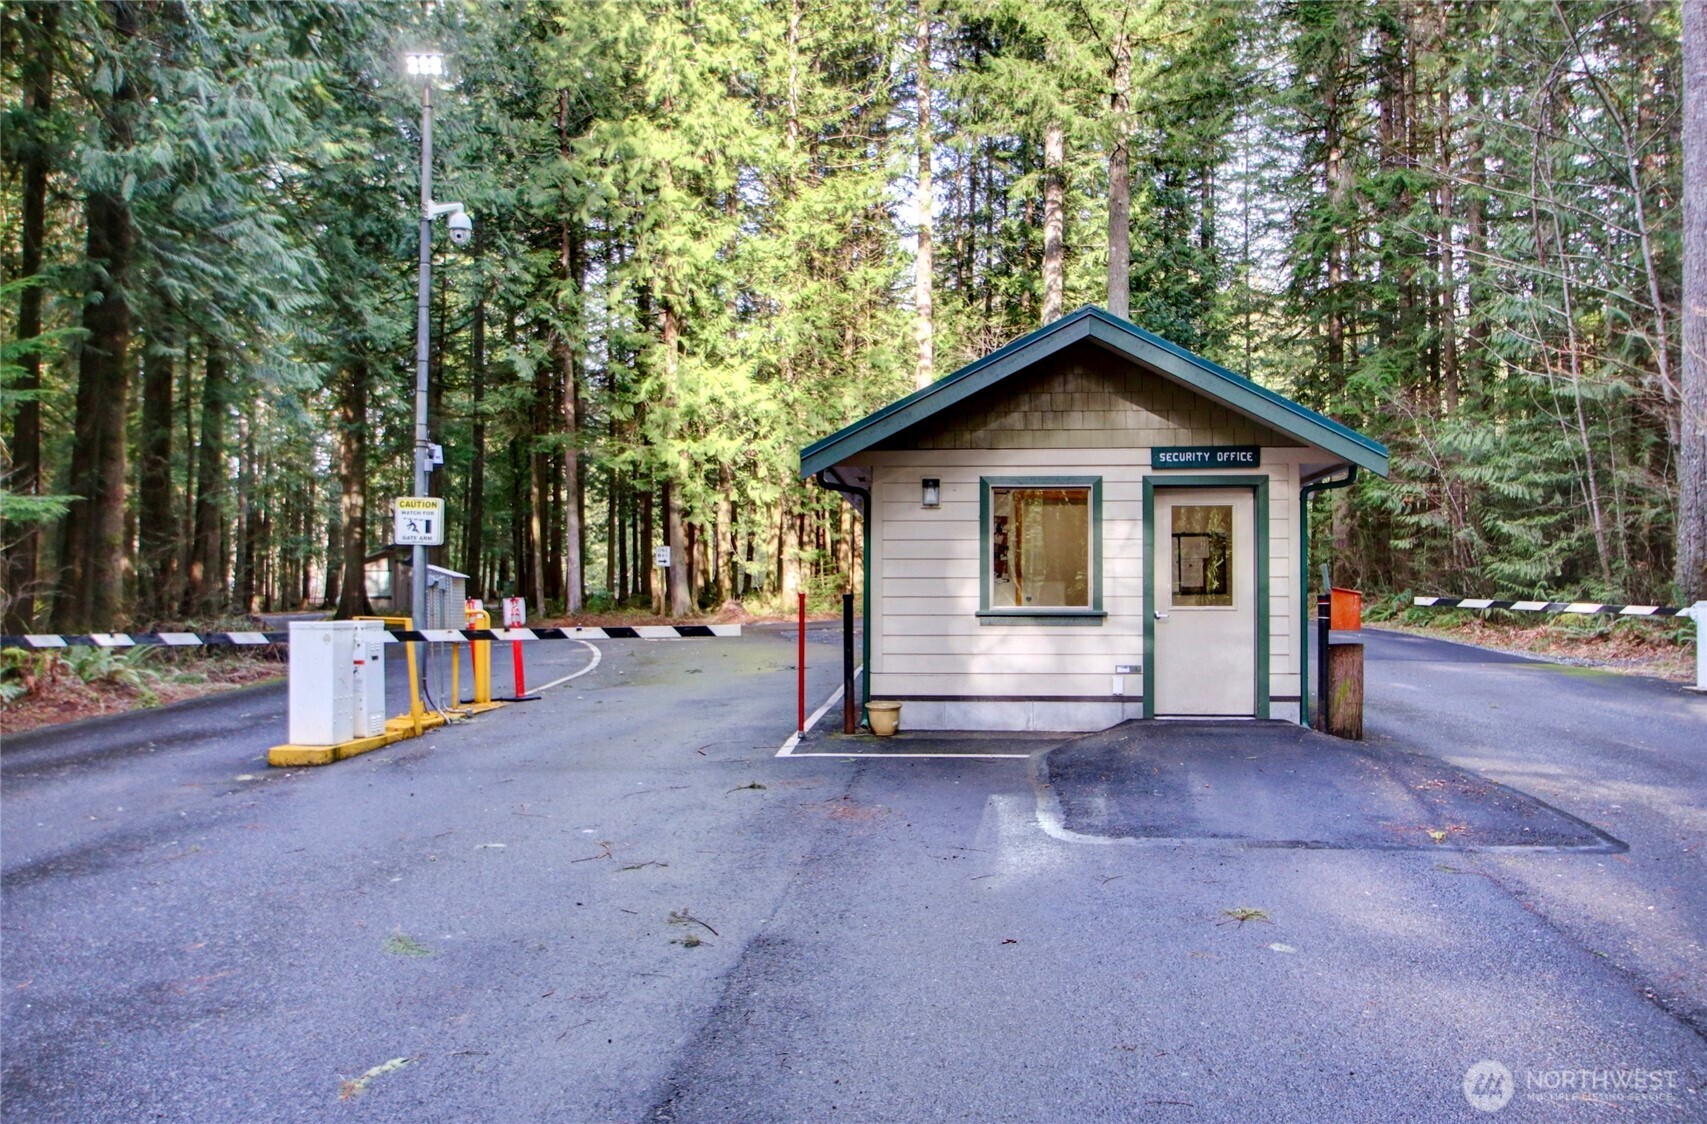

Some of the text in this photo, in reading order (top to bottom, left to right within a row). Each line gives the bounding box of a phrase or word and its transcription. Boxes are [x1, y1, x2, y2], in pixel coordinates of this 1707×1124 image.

[1159, 451, 1253, 462] SECURITY OFFICE
[399, 500, 437, 508] CAUTION
